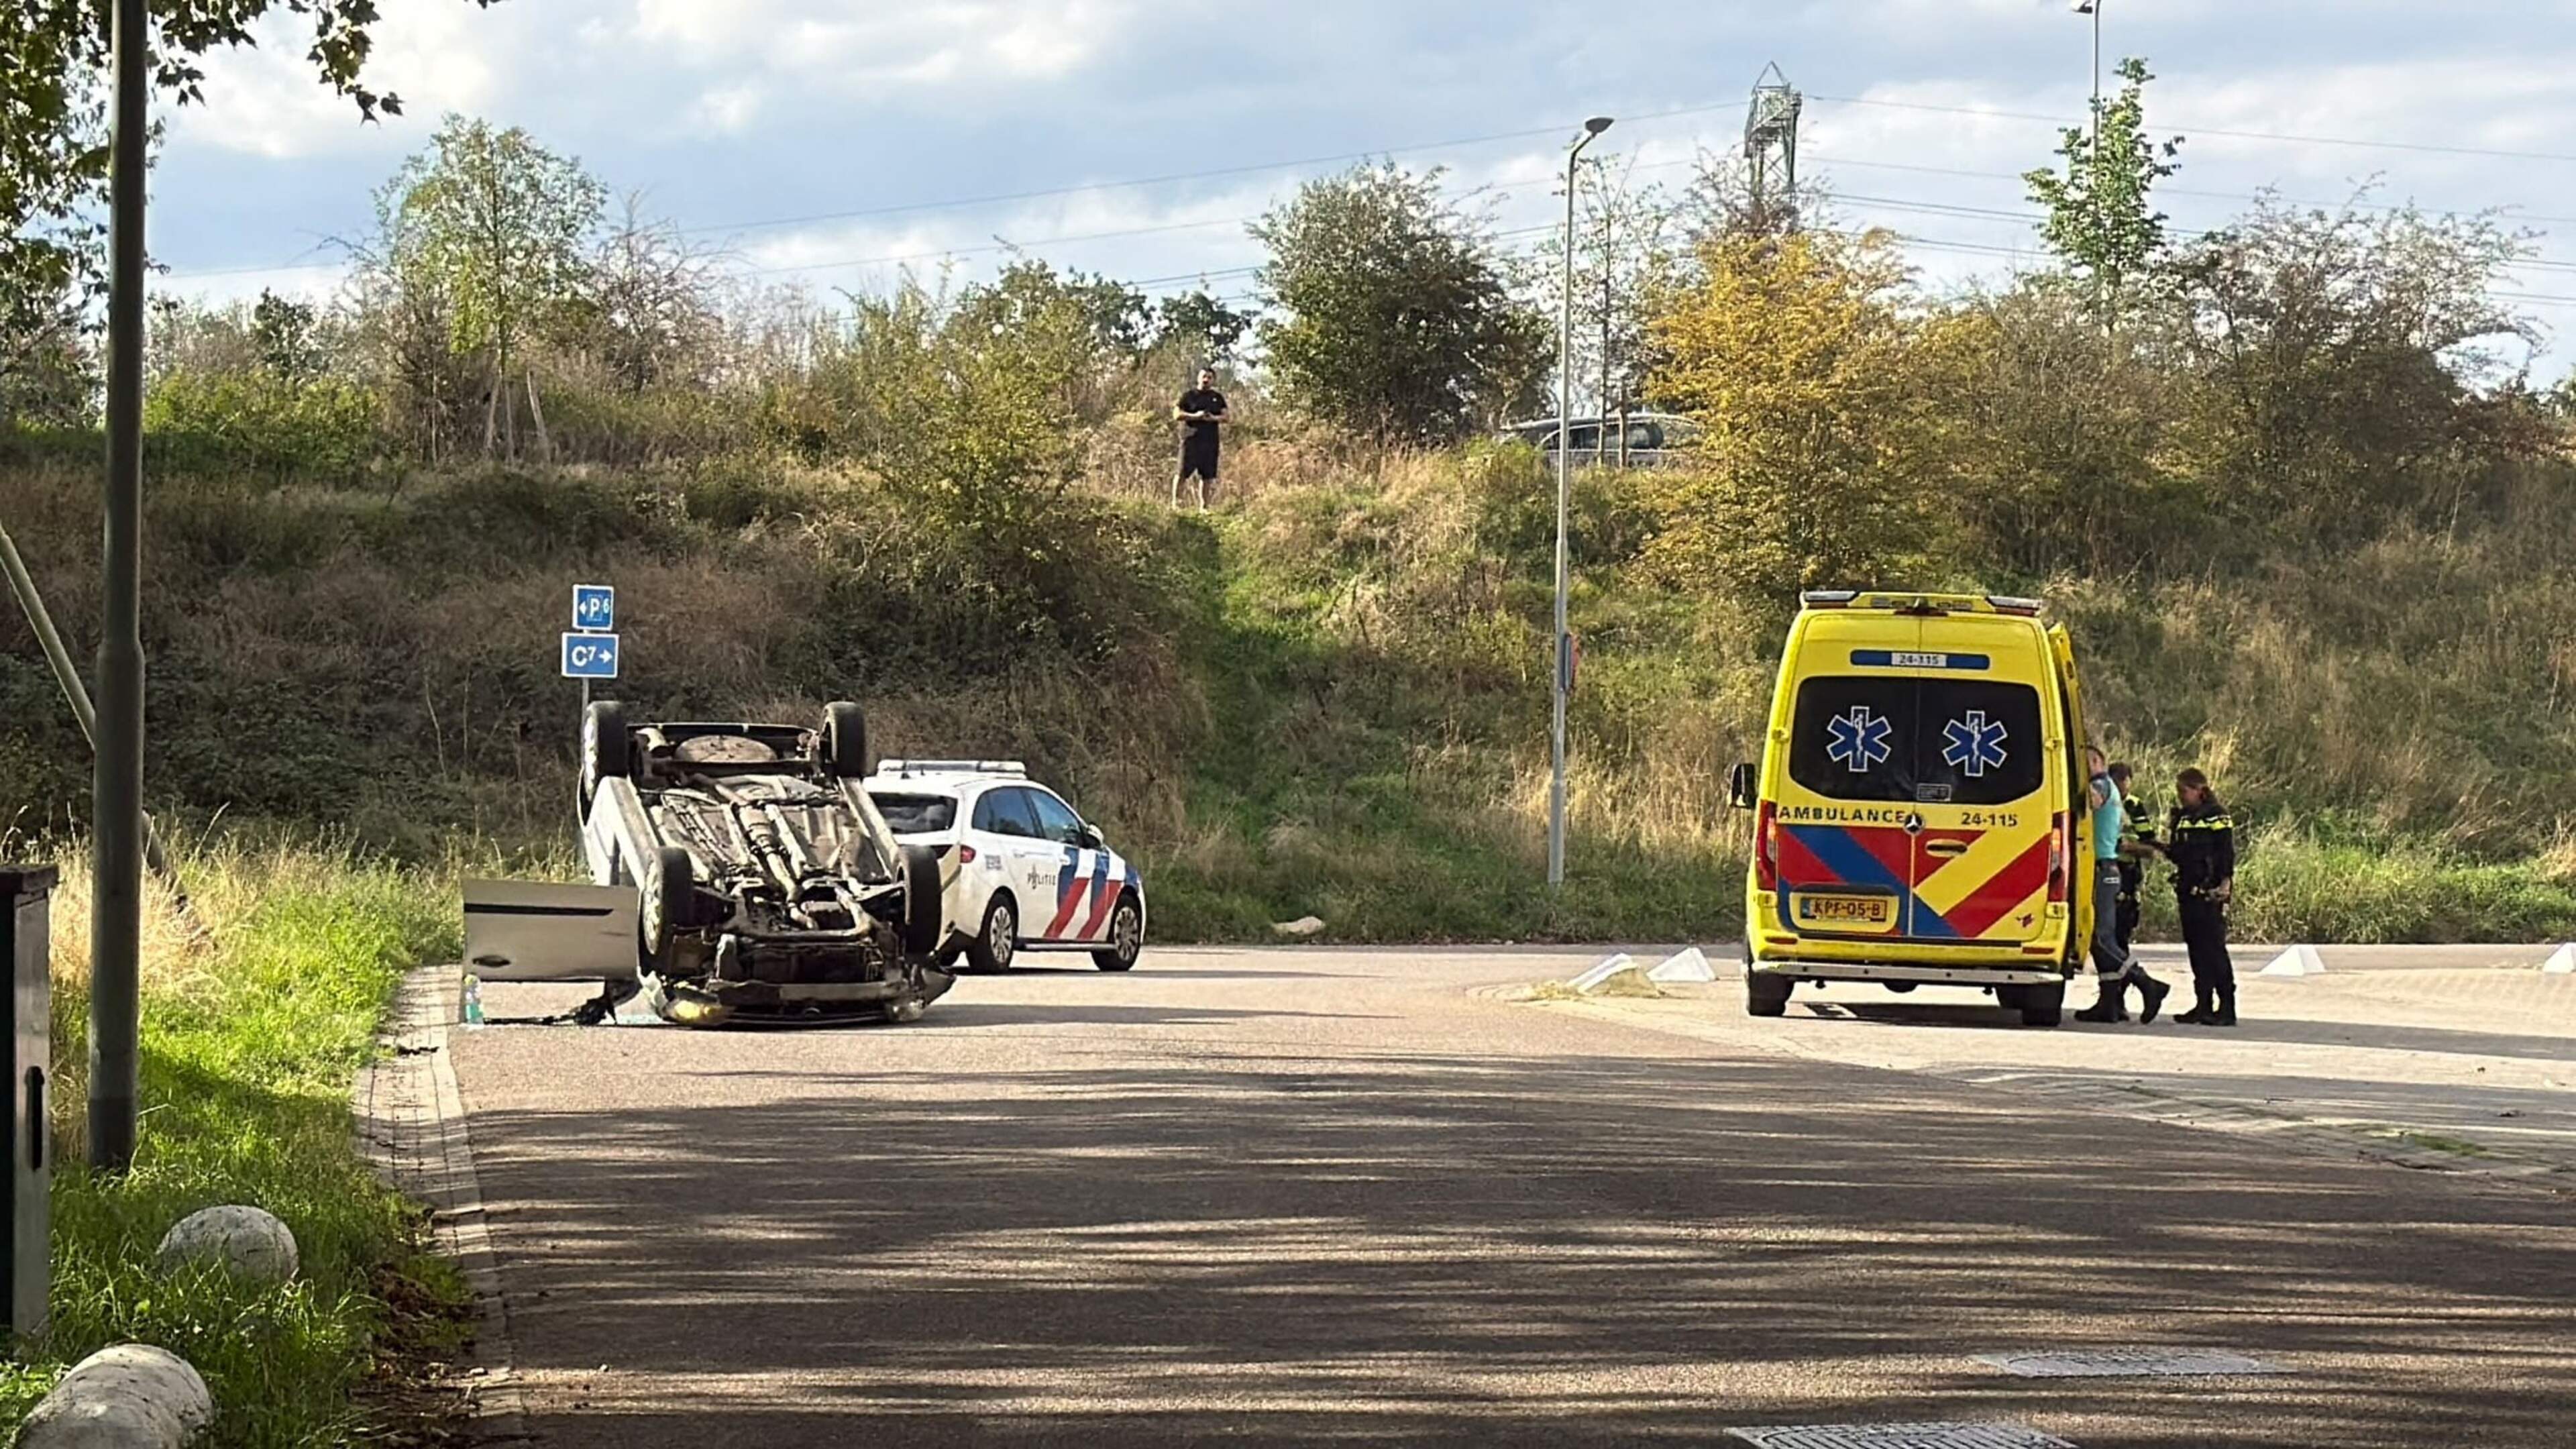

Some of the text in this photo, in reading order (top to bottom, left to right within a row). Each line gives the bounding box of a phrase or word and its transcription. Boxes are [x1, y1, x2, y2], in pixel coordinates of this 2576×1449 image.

[572, 645, 596, 667] C7
[1900, 655, 1939, 664] 24-115
[1778, 806, 1905, 822] AMBULANCE
[1961, 812, 2018, 826] 24-115
